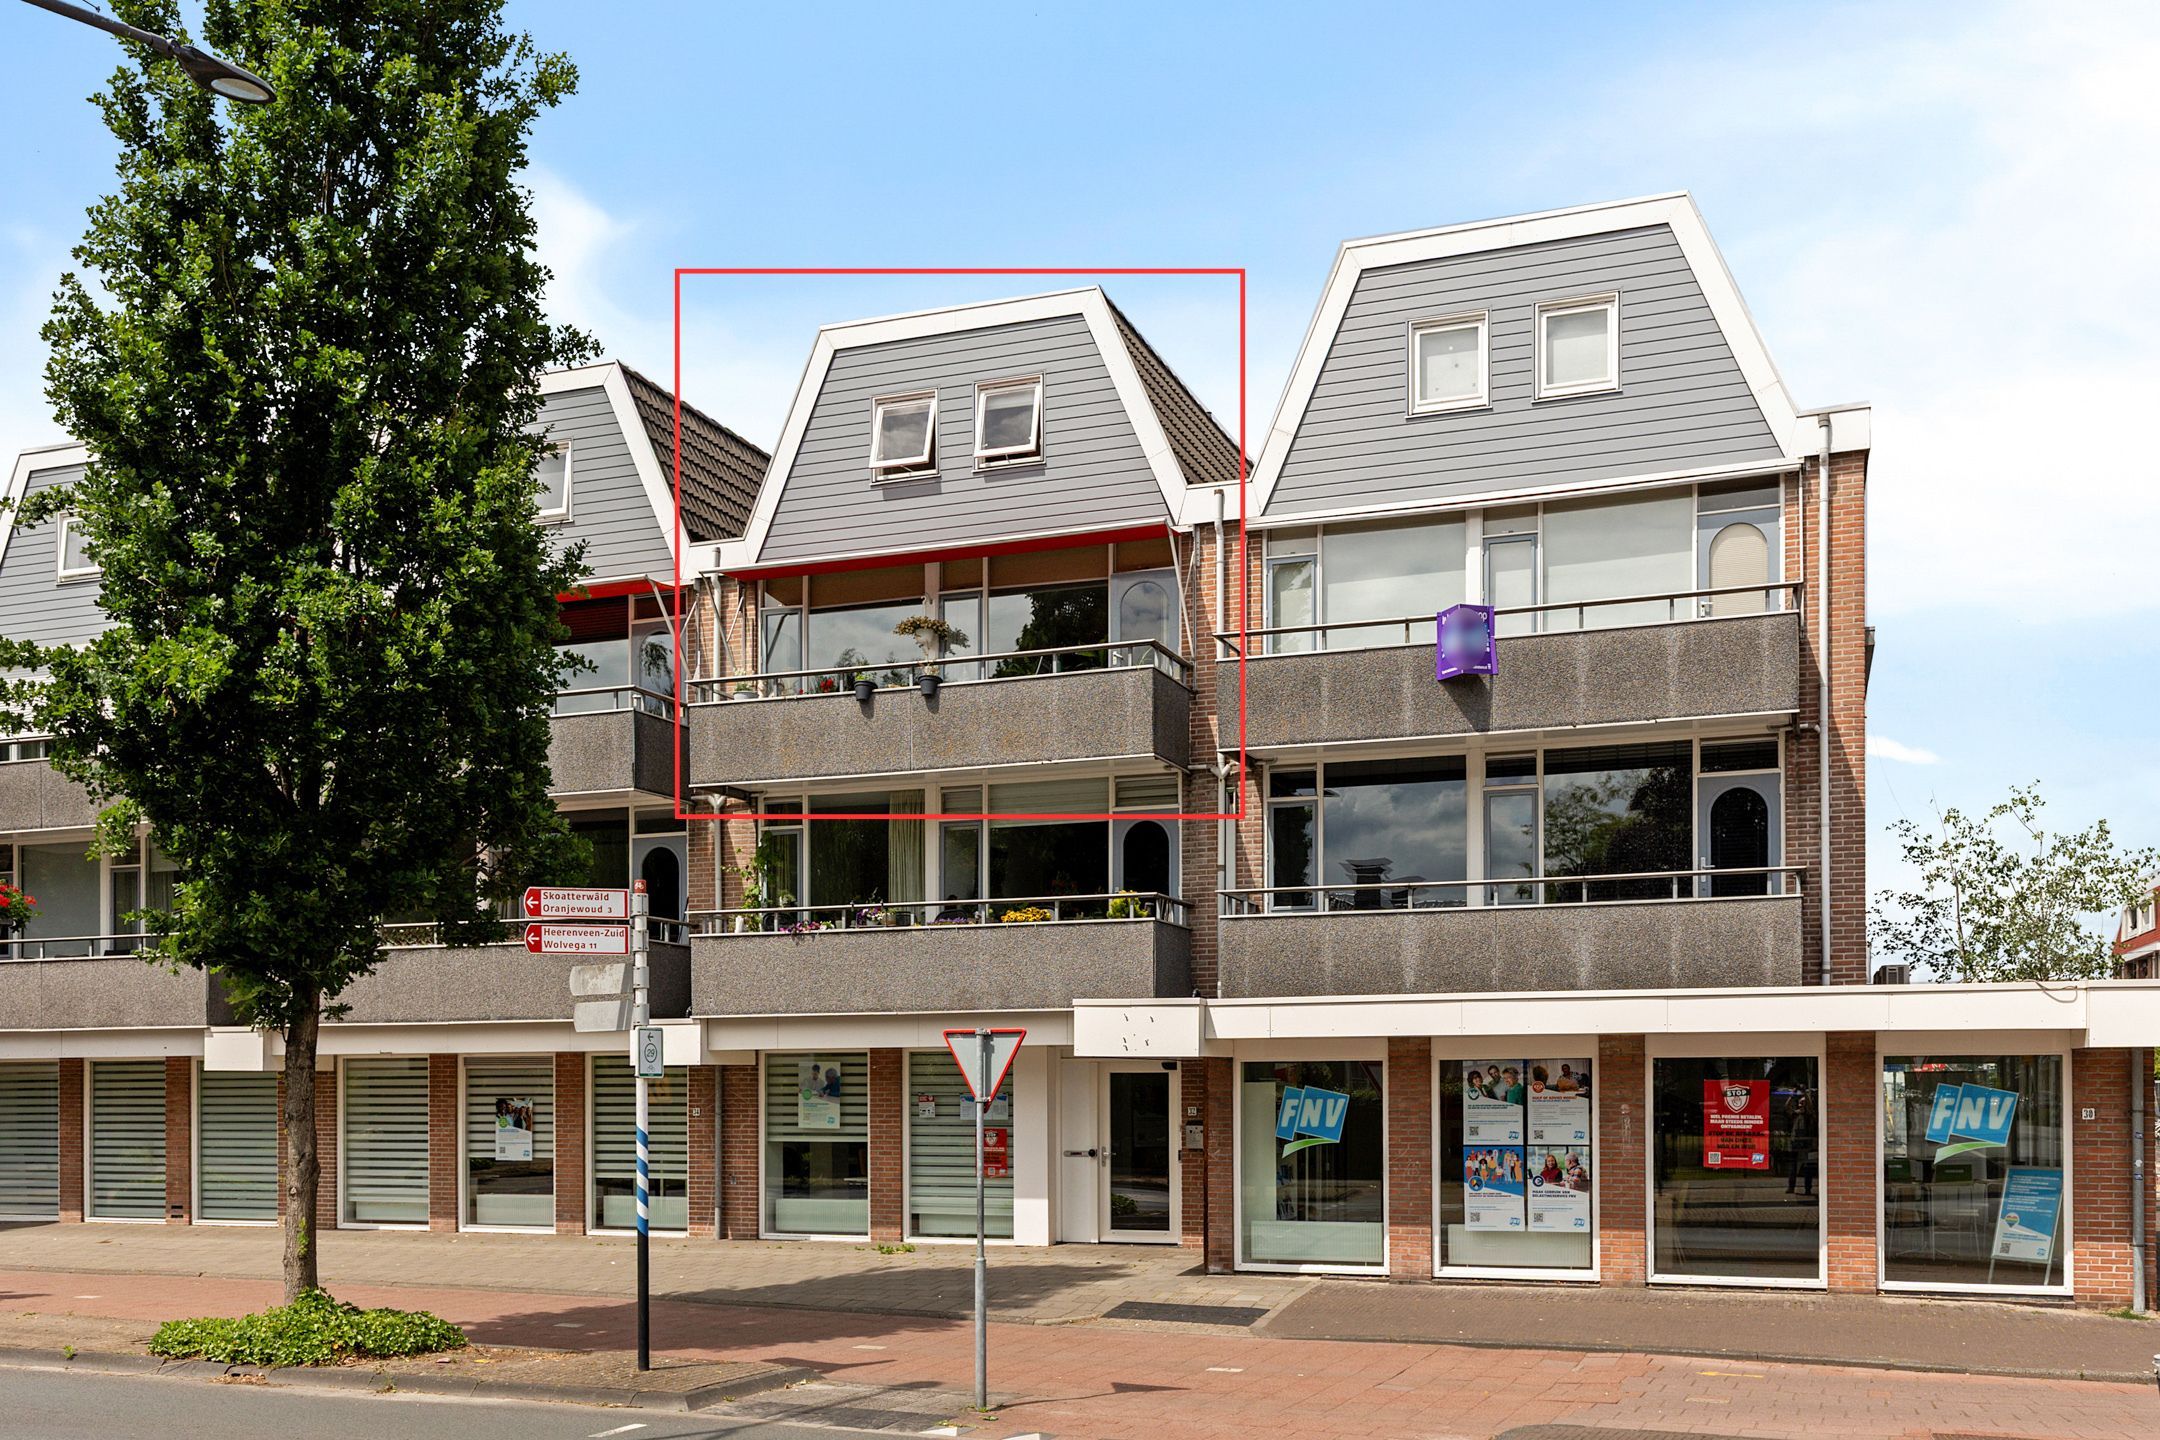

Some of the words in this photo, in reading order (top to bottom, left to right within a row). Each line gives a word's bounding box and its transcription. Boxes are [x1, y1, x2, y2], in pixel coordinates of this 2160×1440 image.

[543, 892, 609, 901] Skoatterwâld
[543, 905, 603, 914] Oranjewoud
[544, 928, 625, 937] Heerenveen-Zuid
[544, 941, 586, 950] Wolvega
[647, 1049, 655, 1057] 29
[1281, 1099, 1346, 1128] FNV
[1933, 1097, 2014, 1130] FNV
